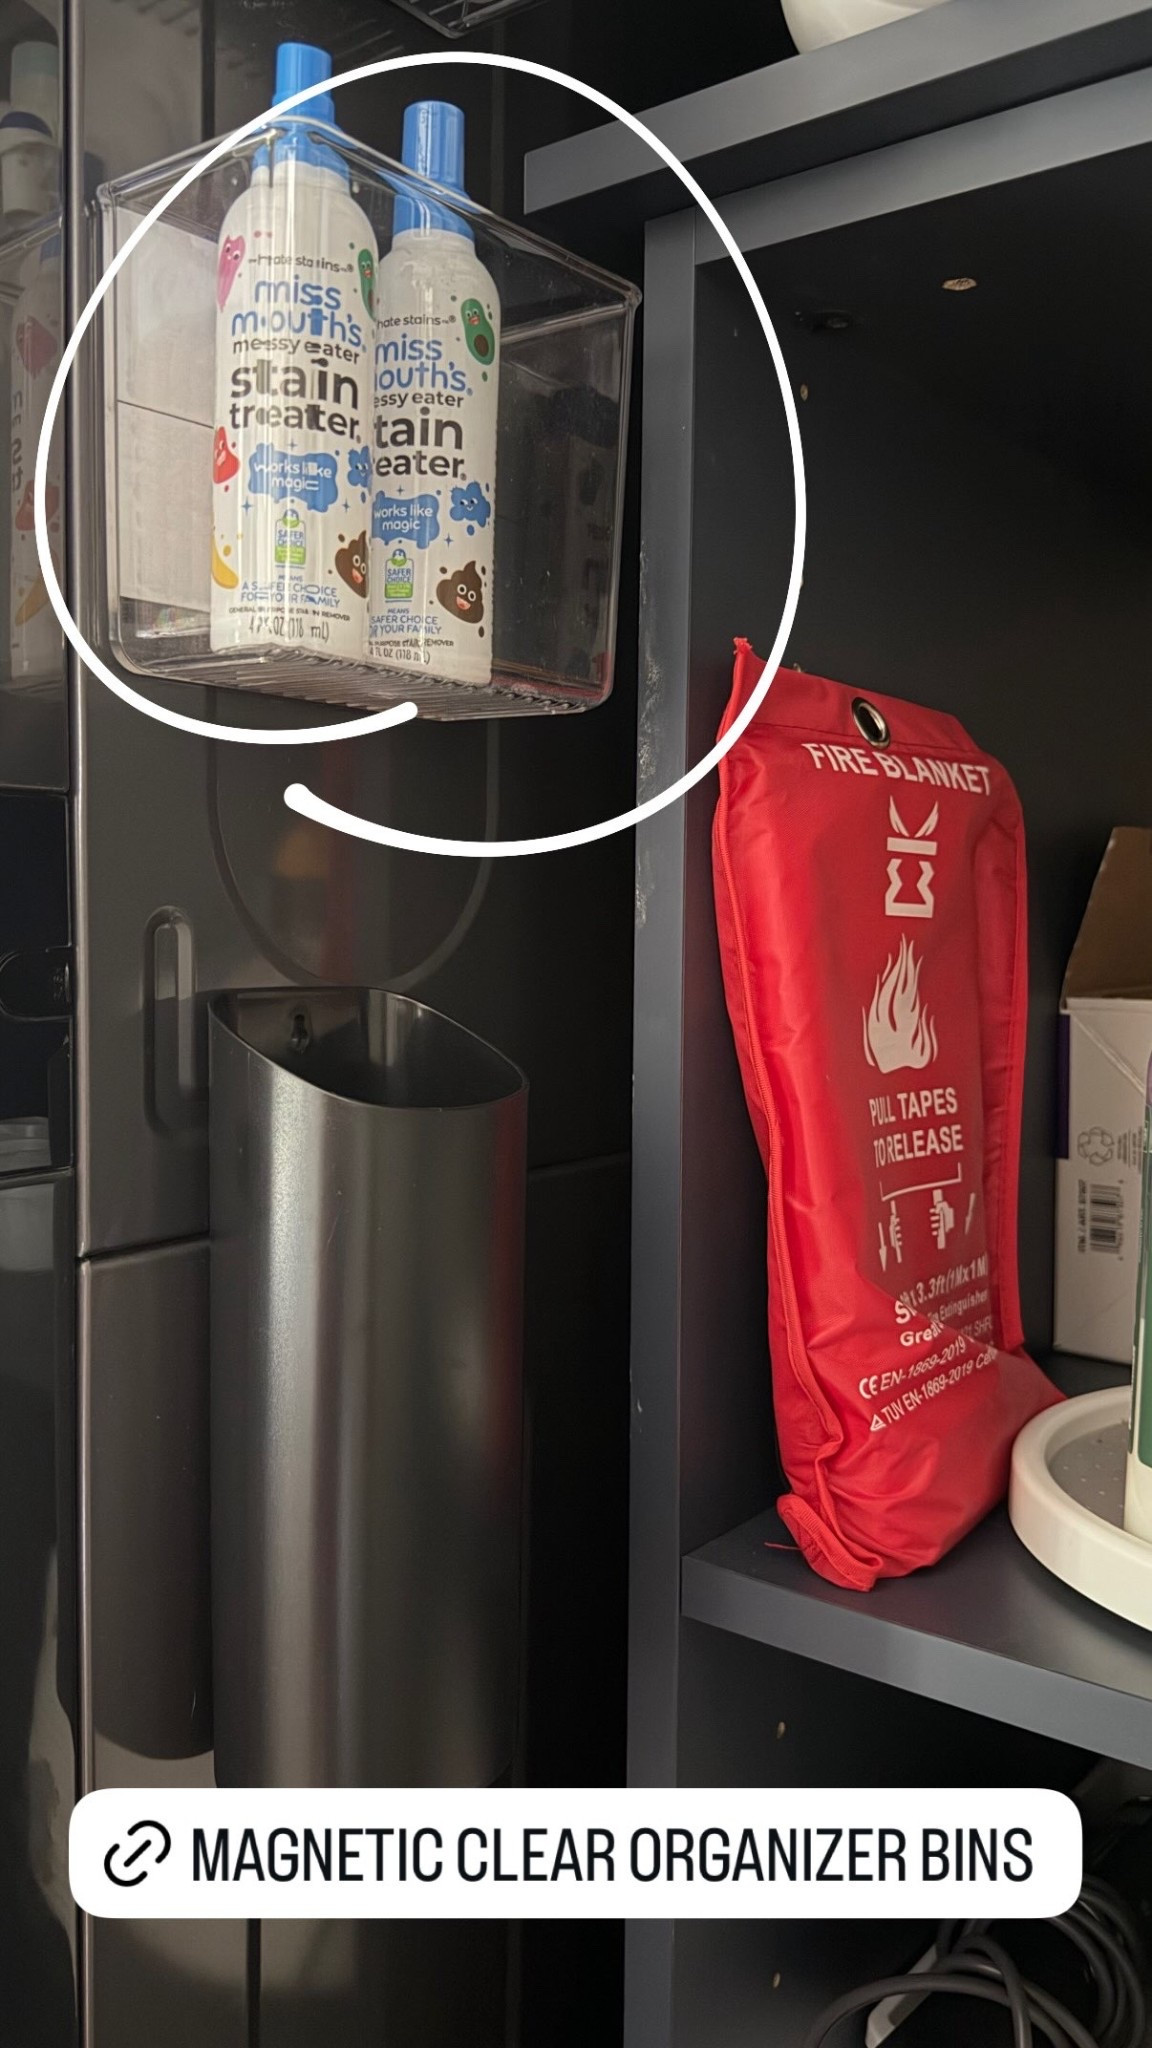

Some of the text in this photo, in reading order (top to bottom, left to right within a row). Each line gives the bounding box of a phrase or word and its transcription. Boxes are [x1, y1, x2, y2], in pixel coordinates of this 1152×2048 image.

[254, 274, 342, 310] miss
[402, 314, 441, 326] stains
[233, 338, 360, 365] messy eater
[374, 333, 443, 364] miss
[231, 358, 358, 410] stain
[374, 361, 467, 393] outh's
[374, 392, 464, 408] essy eater
[374, 406, 463, 451] tain
[253, 461, 332, 478] works like
[373, 449, 465, 479] eater
[271, 475, 320, 492] magic
[373, 504, 433, 518] works like
[382, 518, 421, 533] magic
[387, 568, 411, 577] SAFER
[270, 593, 298, 604] YOR
[293, 583, 337, 598] CHOICE
[380, 624, 404, 637] YOUR
[400, 615, 438, 625] CHOICE
[801, 743, 990, 796] FIRE BLANKET
[868, 1087, 958, 1127] PULL TAPES
[873, 1124, 964, 1168] TO RELEASE
[902, 1360, 974, 1411] EN-1869-2019
